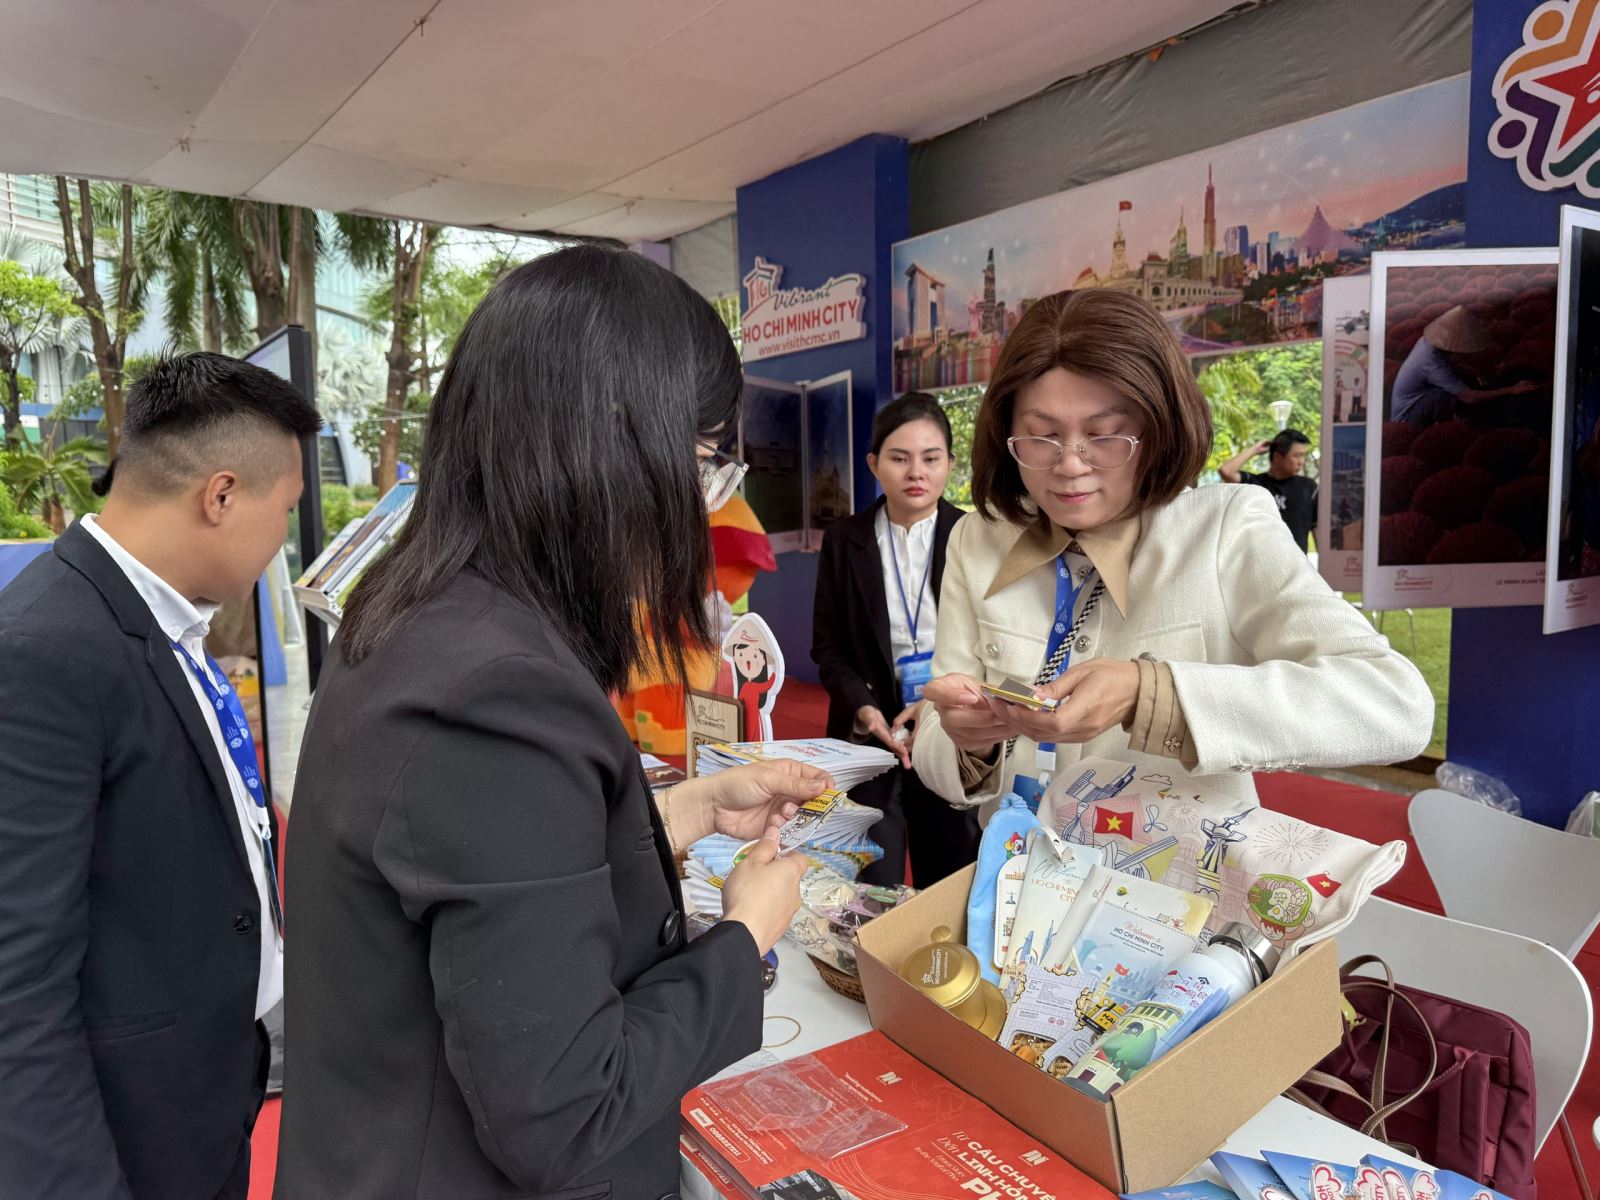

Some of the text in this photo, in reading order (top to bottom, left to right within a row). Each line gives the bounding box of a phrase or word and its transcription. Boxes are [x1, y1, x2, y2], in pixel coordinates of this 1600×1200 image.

[773, 277, 858, 311] Vibrant
[743, 299, 858, 344] HO CHI MINH CITY
[758, 330, 840, 356] www.visithcmc.vn
[1060, 885, 1080, 898] MIN
[1060, 894, 1077, 903] CIT
[1114, 926, 1124, 935] HO
[1124, 929, 1136, 940] CHI
[1135, 933, 1151, 947] MINH
[1150, 941, 1166, 952] CITY
[967, 1141, 1003, 1165] CÂU
[957, 1152, 999, 1182] LINH
[1326, 1187, 1336, 1200] LOV
